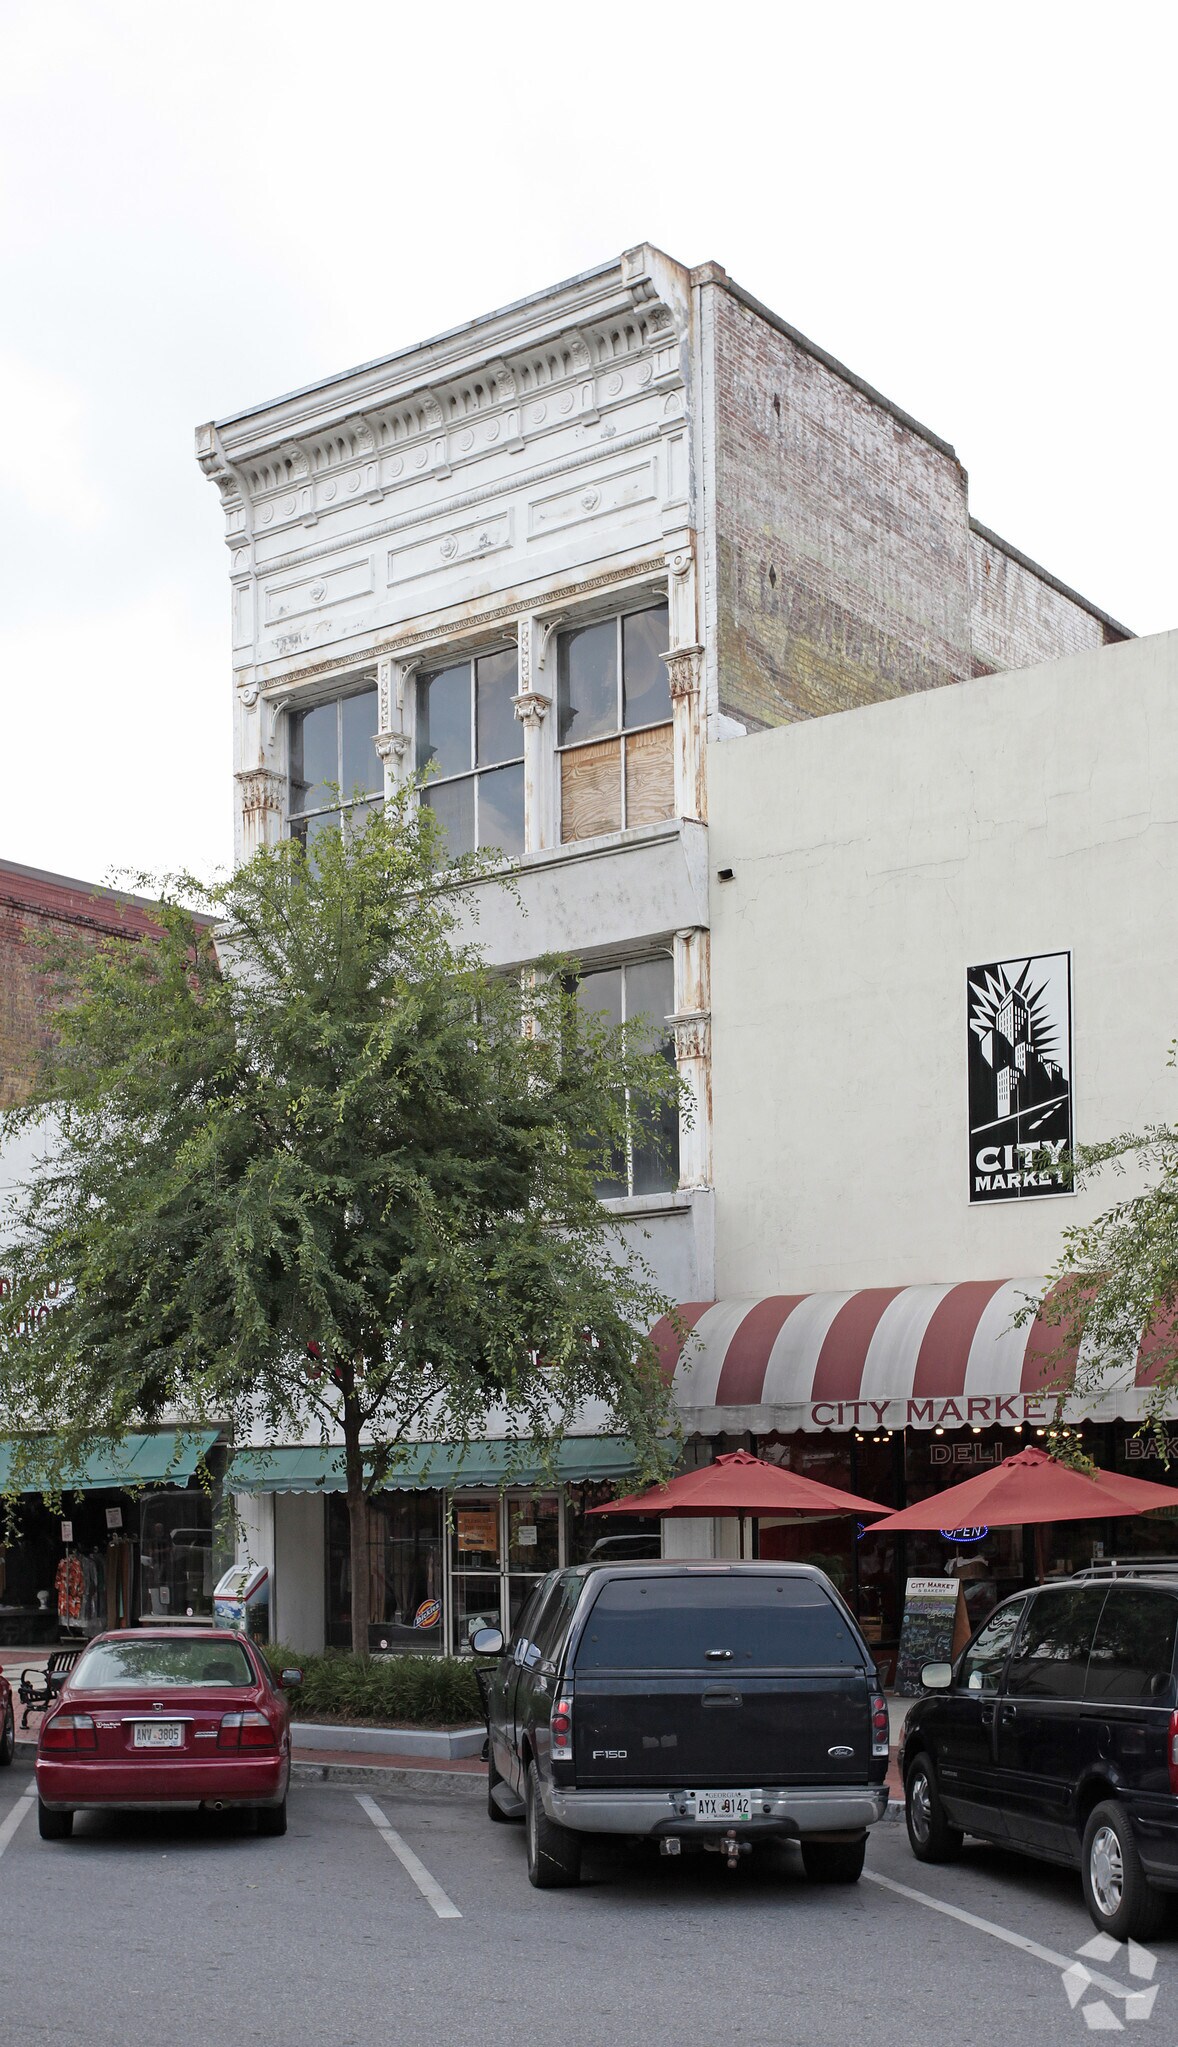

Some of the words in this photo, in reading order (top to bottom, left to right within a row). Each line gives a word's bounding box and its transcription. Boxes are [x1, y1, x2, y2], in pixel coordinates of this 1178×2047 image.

[975, 1139, 1067, 1173] CITY
[811, 1401, 892, 1426] CITY
[906, 1394, 1072, 1423] MARKET
[930, 1442, 1003, 1465] DELI
[944, 1526, 981, 1538] OPEN
[927, 1582, 955, 1590] MARKET
[136, 1728, 152, 1741] ANV
[158, 1728, 179, 1740] 3805
[698, 1799, 717, 1814] AYX
[724, 1798, 749, 1813] 9142
